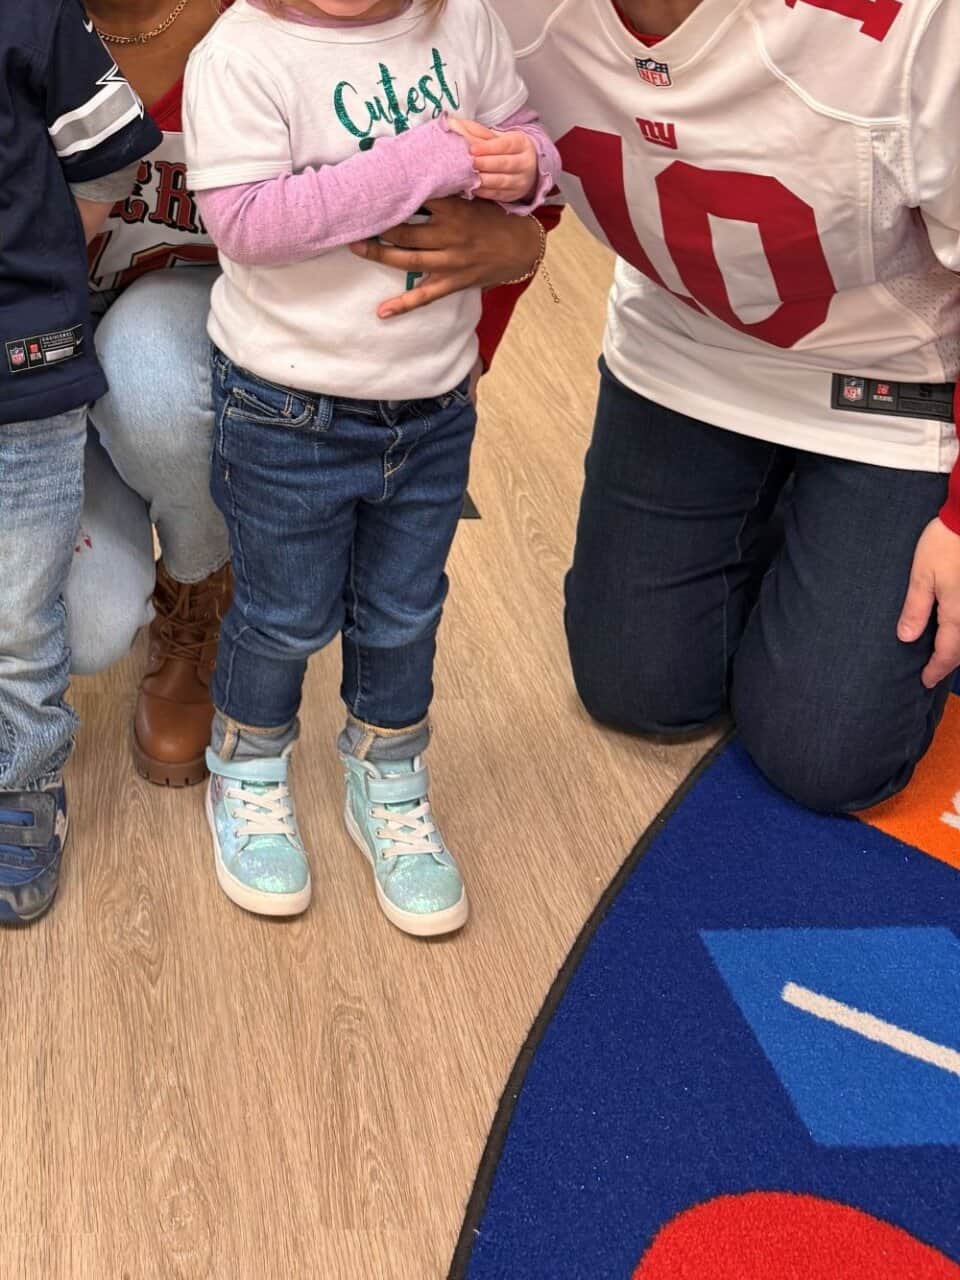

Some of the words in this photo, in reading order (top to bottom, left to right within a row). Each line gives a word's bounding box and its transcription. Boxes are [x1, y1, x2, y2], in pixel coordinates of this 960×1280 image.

[333, 47, 460, 139] Cutest
[640, 70, 668, 86] NFL
[554, 125, 837, 349] 10
